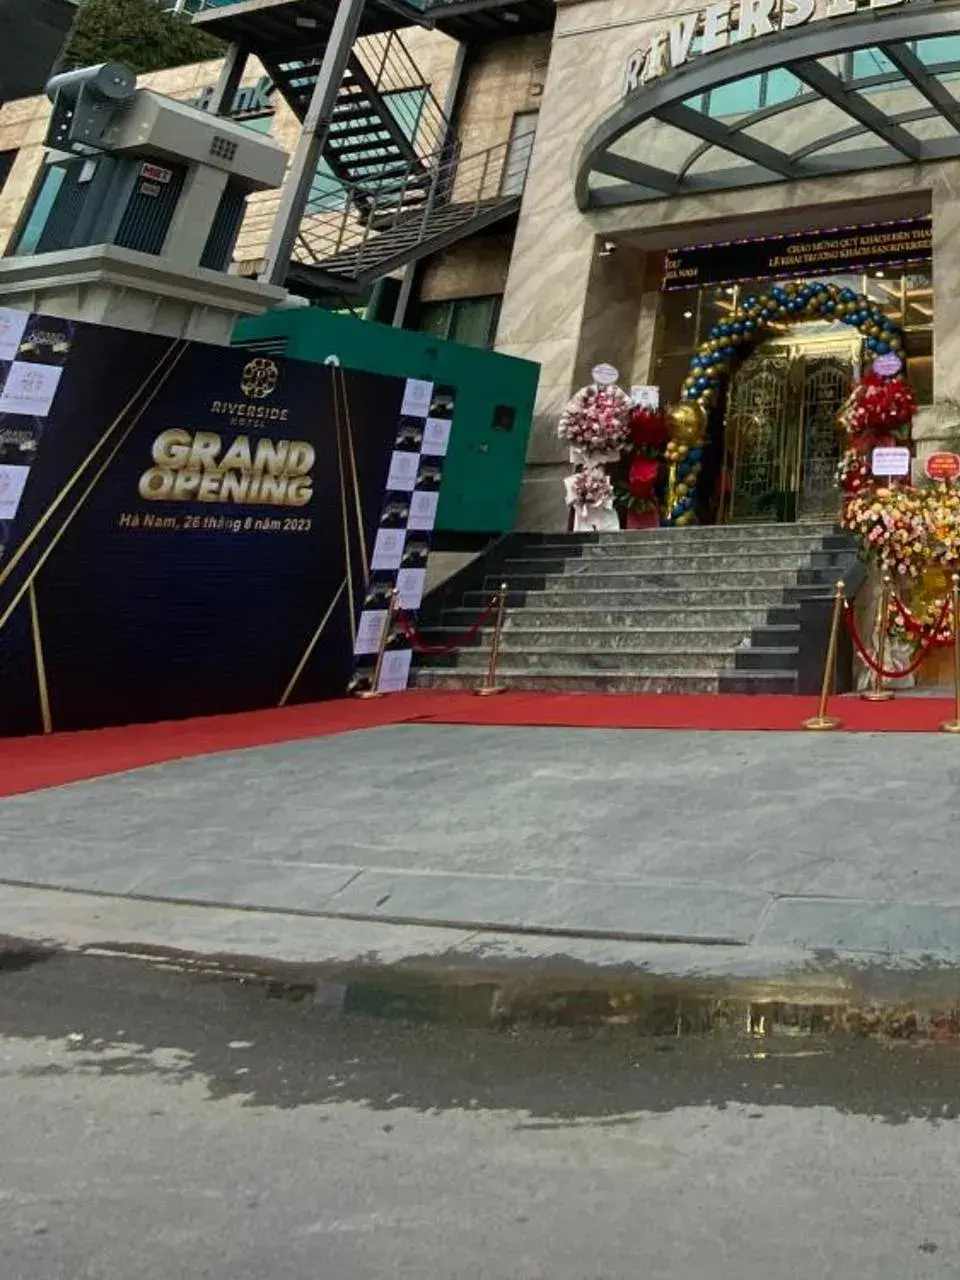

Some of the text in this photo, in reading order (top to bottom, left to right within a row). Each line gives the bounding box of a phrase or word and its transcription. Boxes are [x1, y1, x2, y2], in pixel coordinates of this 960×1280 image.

[211, 401, 289, 420] RIVERSIDE
[152, 428, 315, 475] GRAND
[138, 467, 314, 506] OPENING
[119, 513, 139, 527] Hà
[203, 514, 240, 532] tháng
[254, 516, 281, 530] năm
[283, 517, 312, 531] 2023
